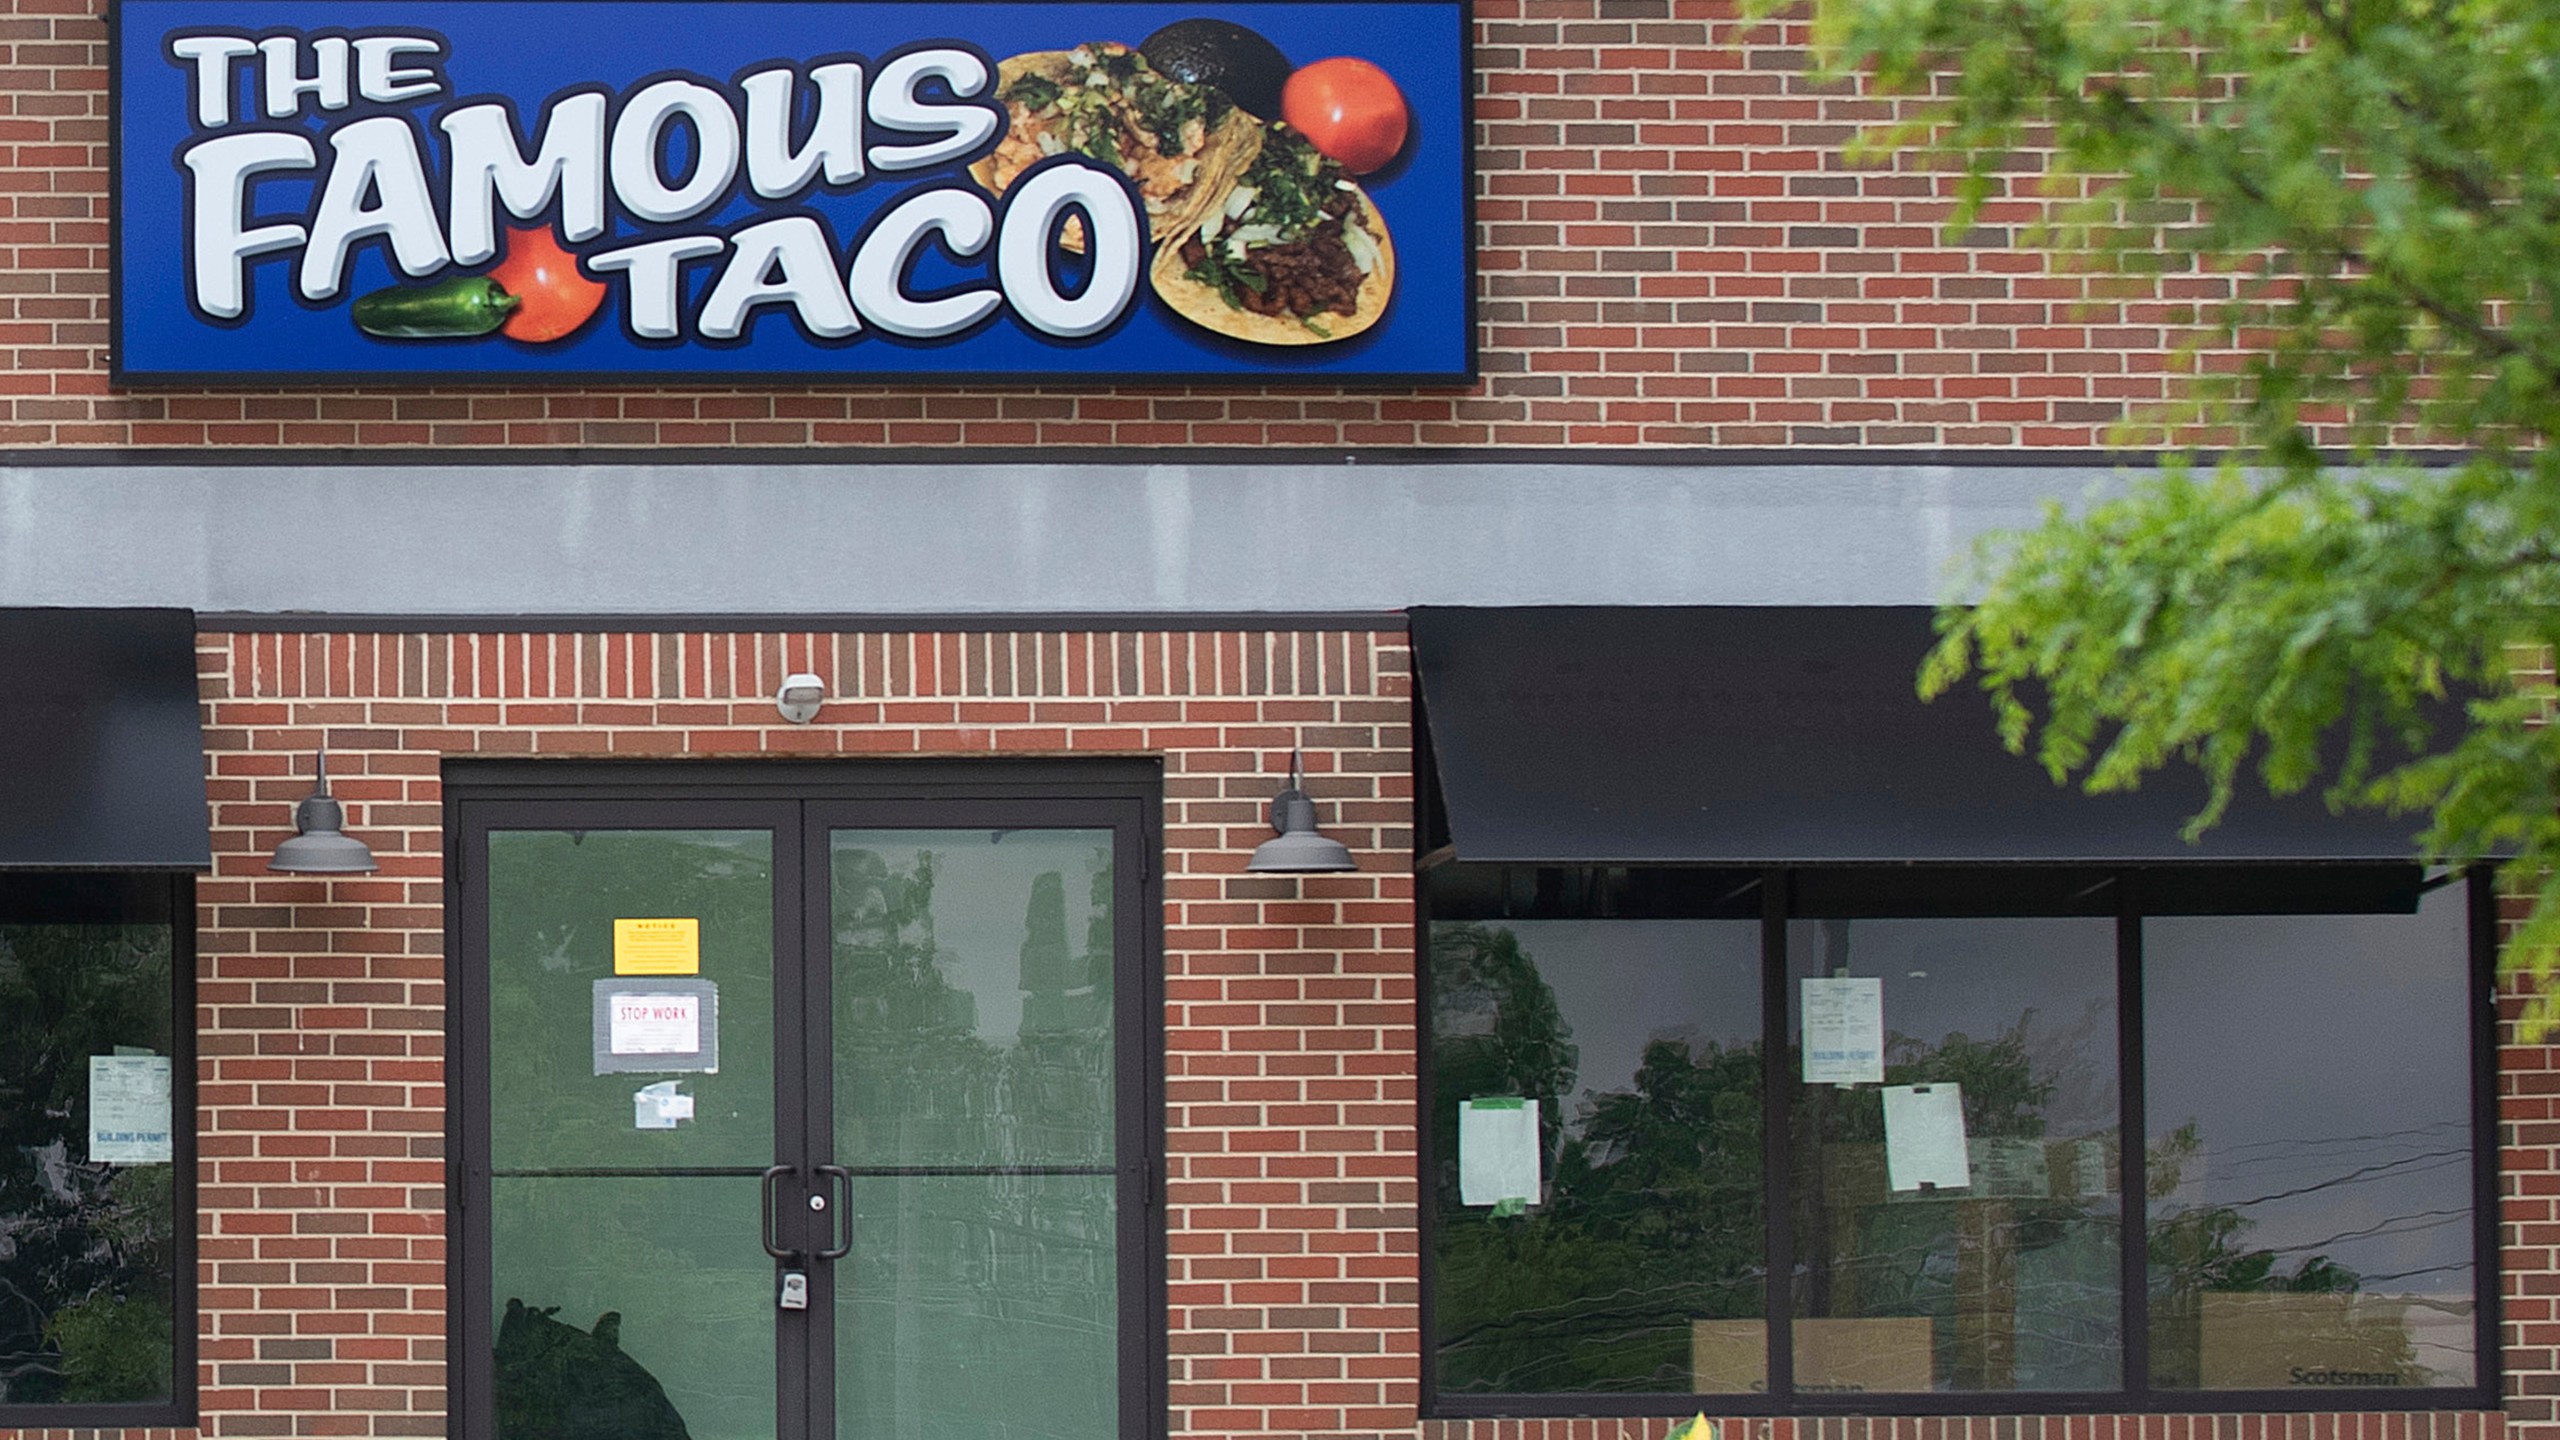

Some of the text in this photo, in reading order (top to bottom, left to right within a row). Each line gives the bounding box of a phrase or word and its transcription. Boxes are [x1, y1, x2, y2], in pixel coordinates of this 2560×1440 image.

[172, 36, 443, 128] THE
[182, 47, 1000, 320] FAMOUS
[585, 162, 1141, 339] TACO
[621, 1006, 687, 1020] STOP WORK
[96, 1132, 167, 1142] BUILDING PERMIT
[2289, 1366, 2398, 1386] Scotsman
